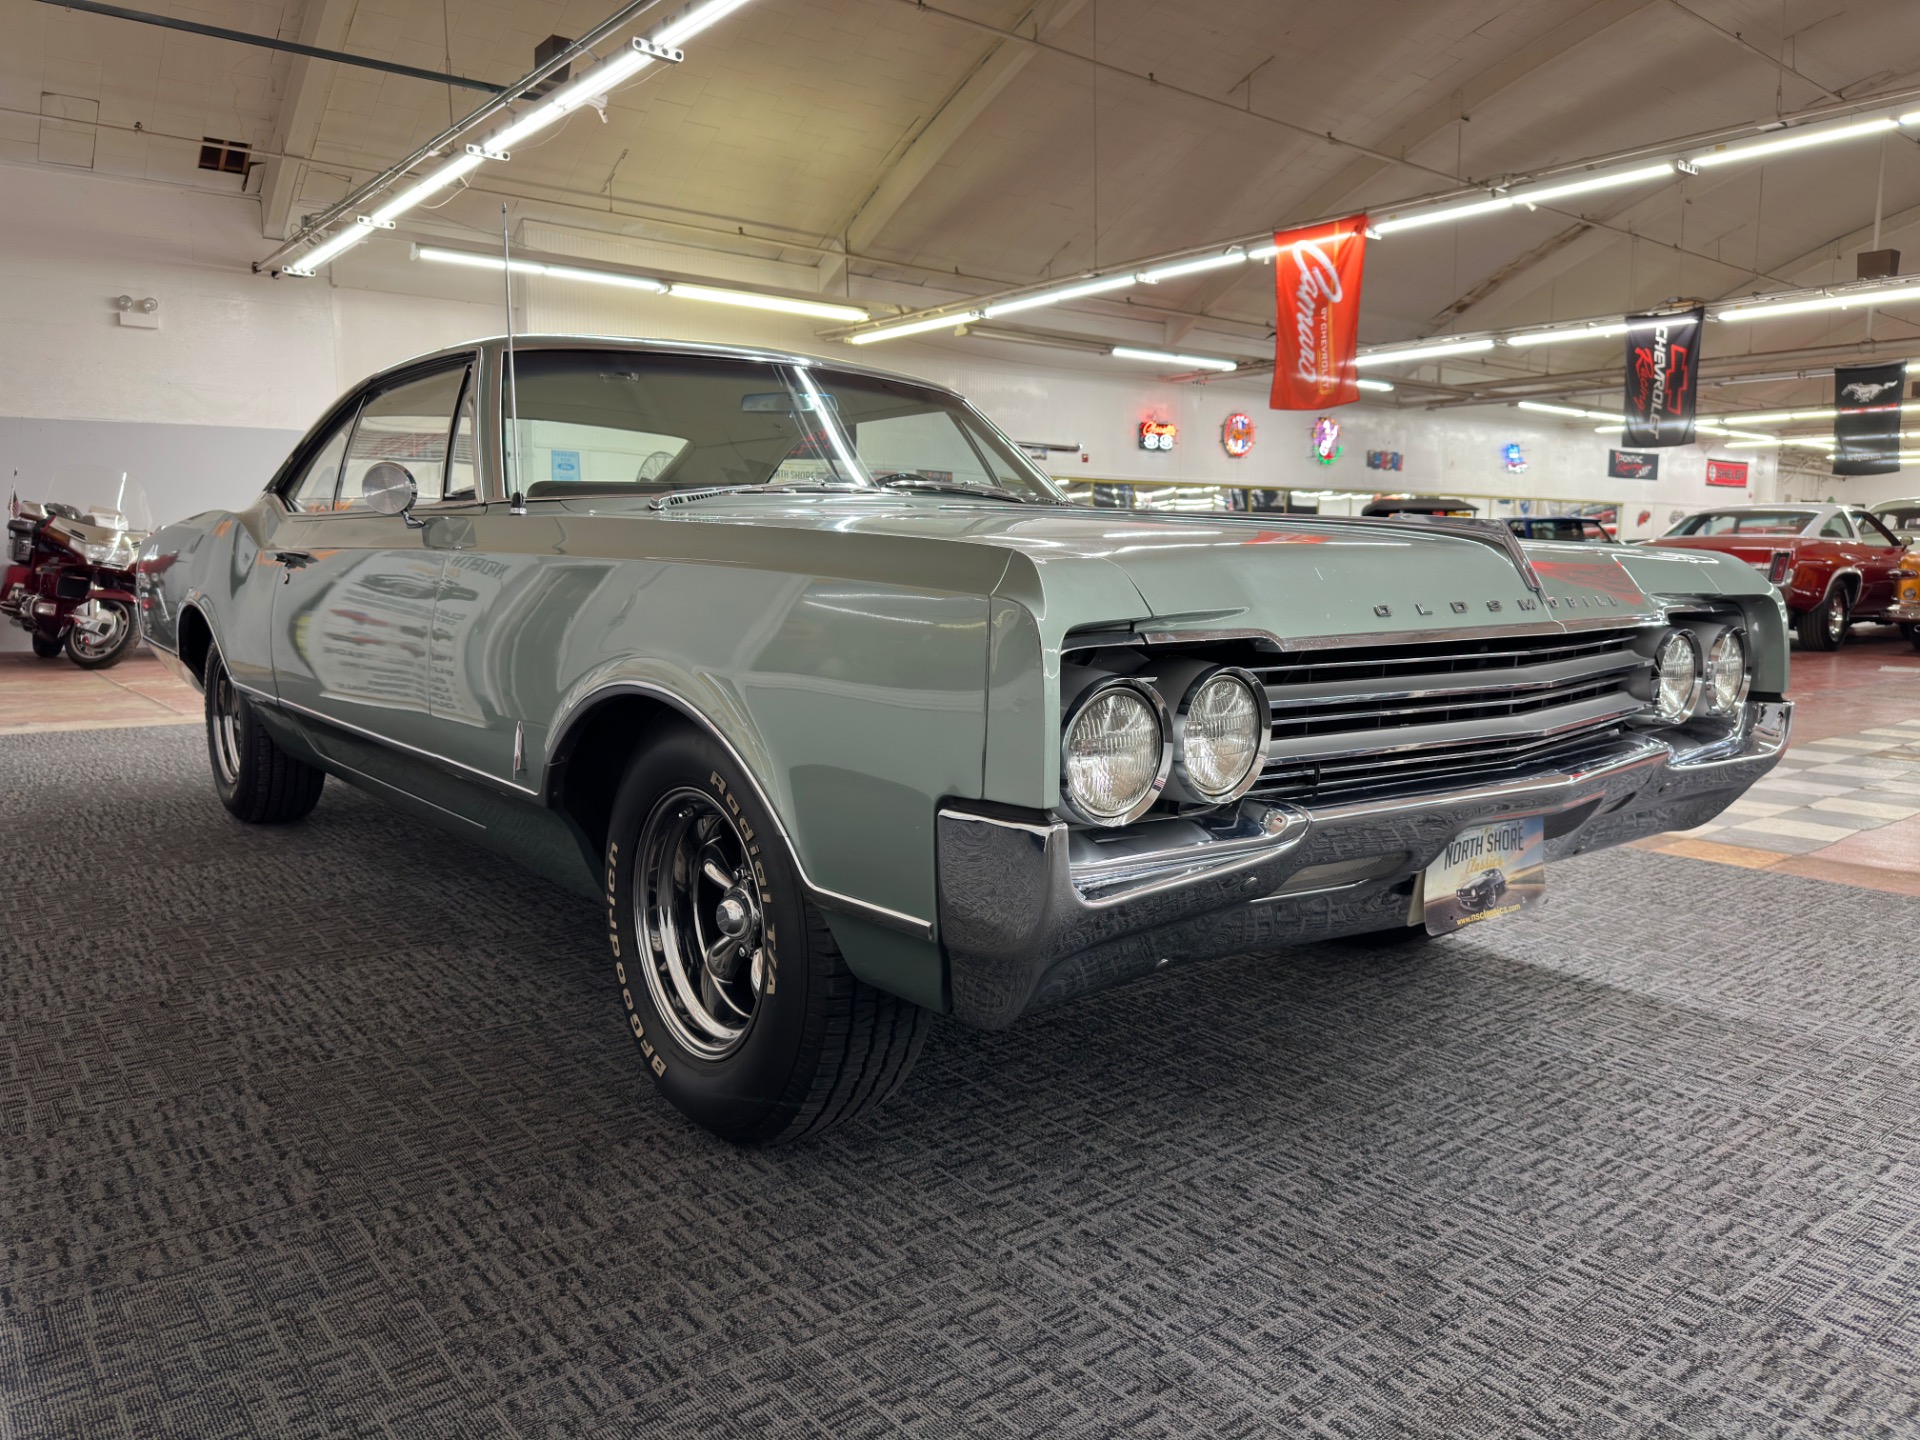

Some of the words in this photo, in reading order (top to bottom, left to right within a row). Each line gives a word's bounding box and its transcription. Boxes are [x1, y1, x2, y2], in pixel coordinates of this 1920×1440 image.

[1292, 240, 1343, 384] Camaro
[1649, 325, 1668, 439] CHEVROLET
[1717, 468, 1745, 480] SHELBY
[710, 770, 772, 905] Radial
[765, 922, 779, 995] T/A
[1444, 835, 1484, 870] NORTH
[1487, 826, 1524, 853] SHORE
[1465, 855, 1505, 874] Classics
[606, 840, 667, 1079] BFGoodrich
